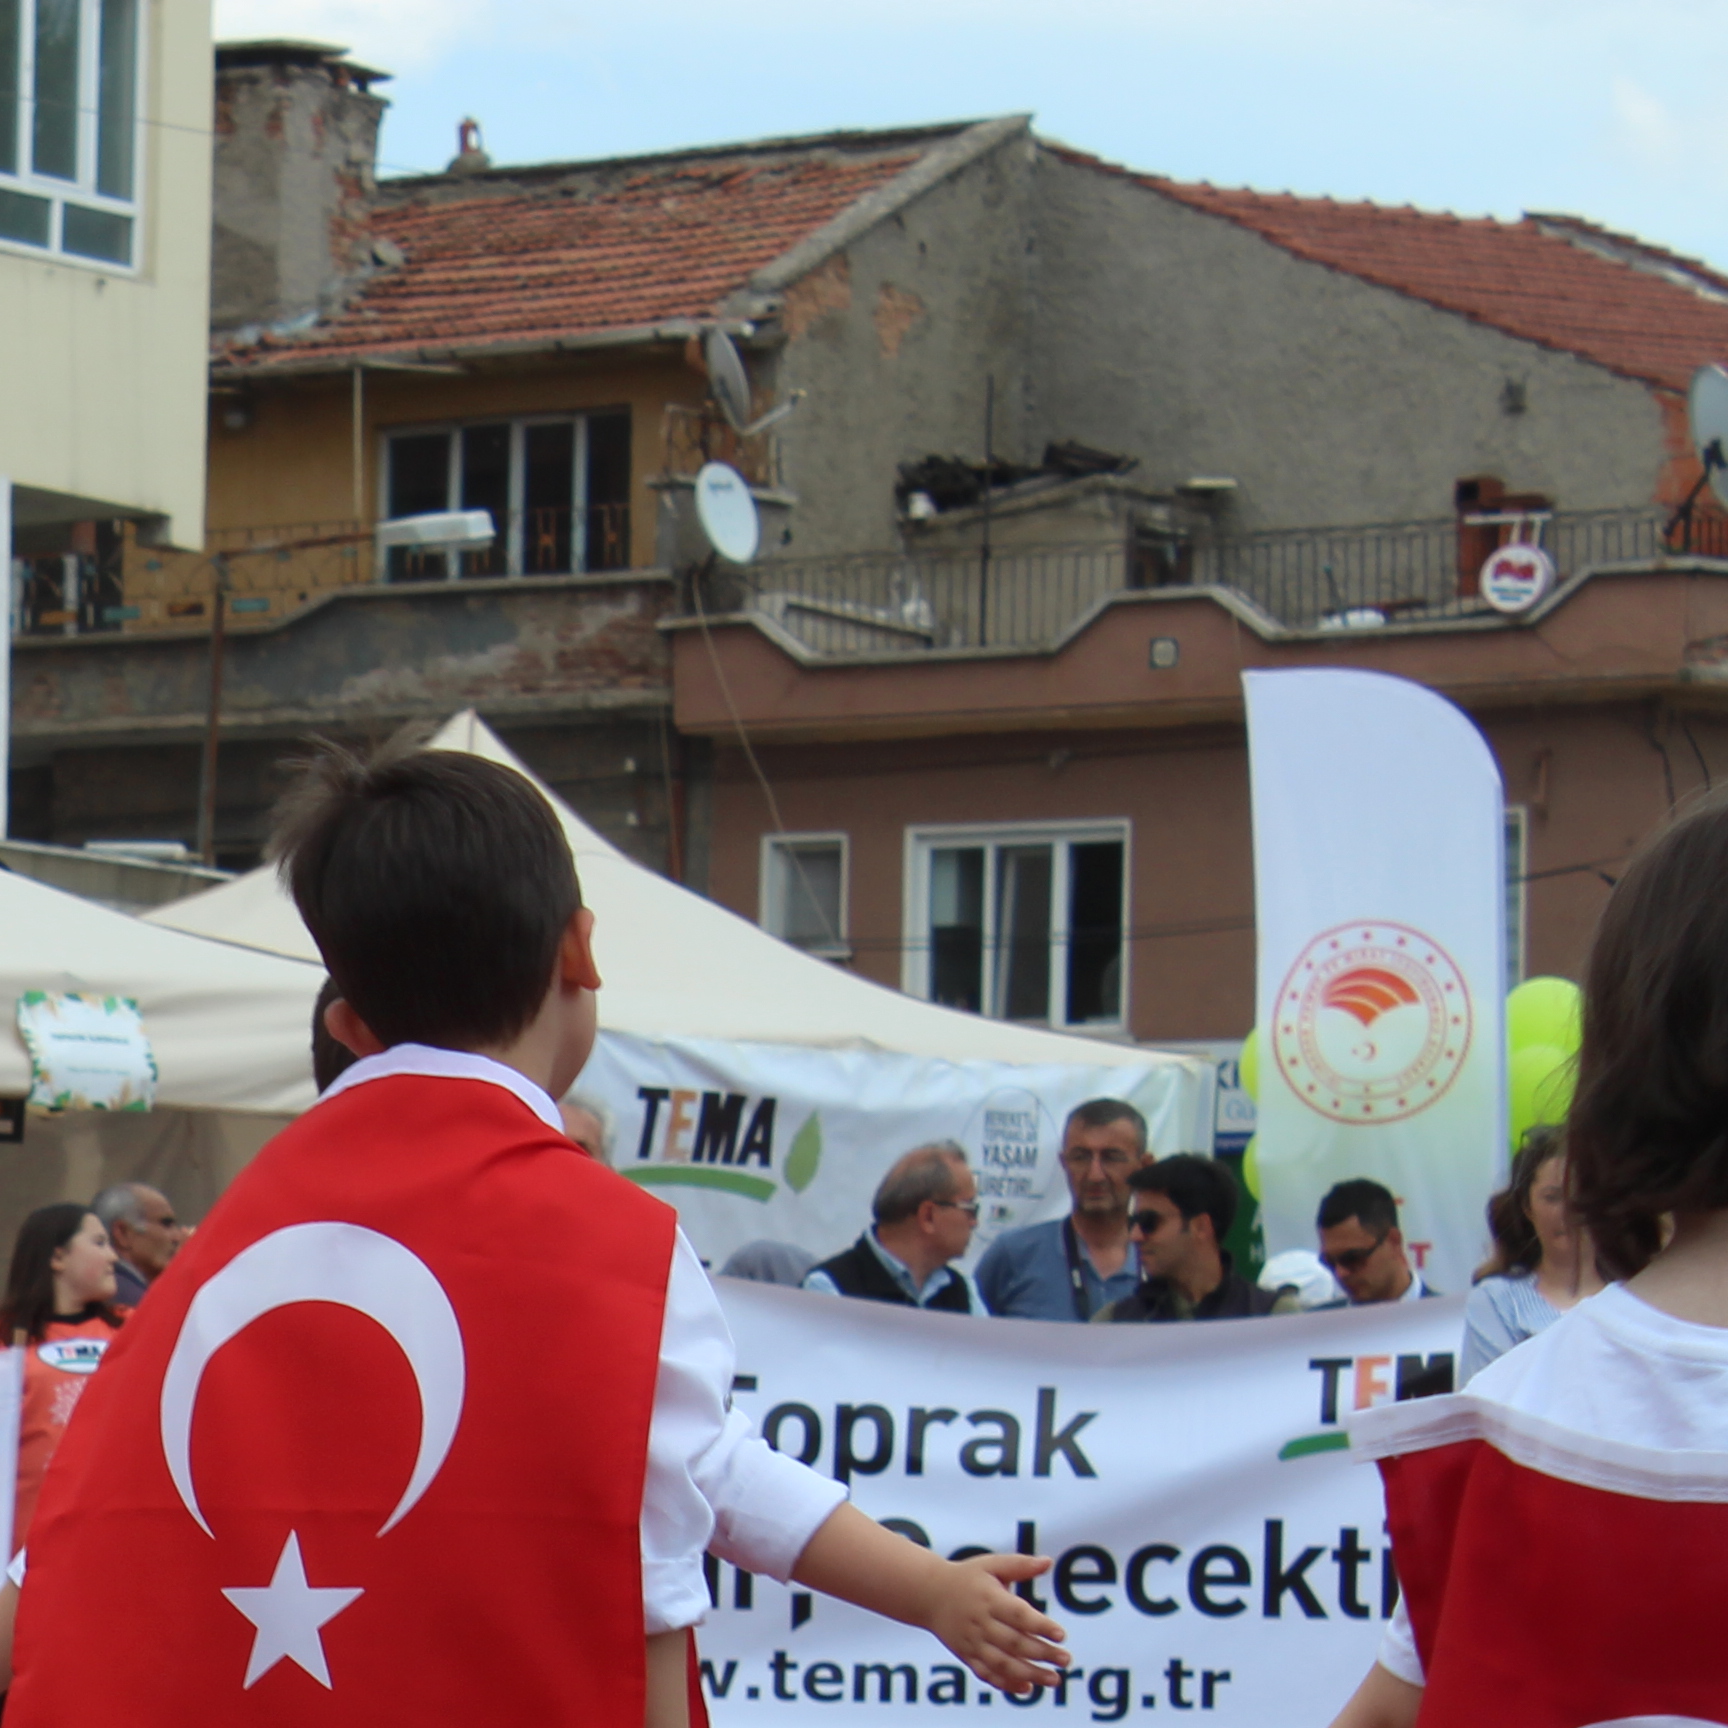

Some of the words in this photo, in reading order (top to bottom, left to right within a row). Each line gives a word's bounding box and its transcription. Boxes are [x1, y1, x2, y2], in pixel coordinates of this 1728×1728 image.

[636, 1086, 778, 1168] TEMA
[732, 1374, 1101, 1500] oprak
[876, 1517, 1401, 1621] lecekti
